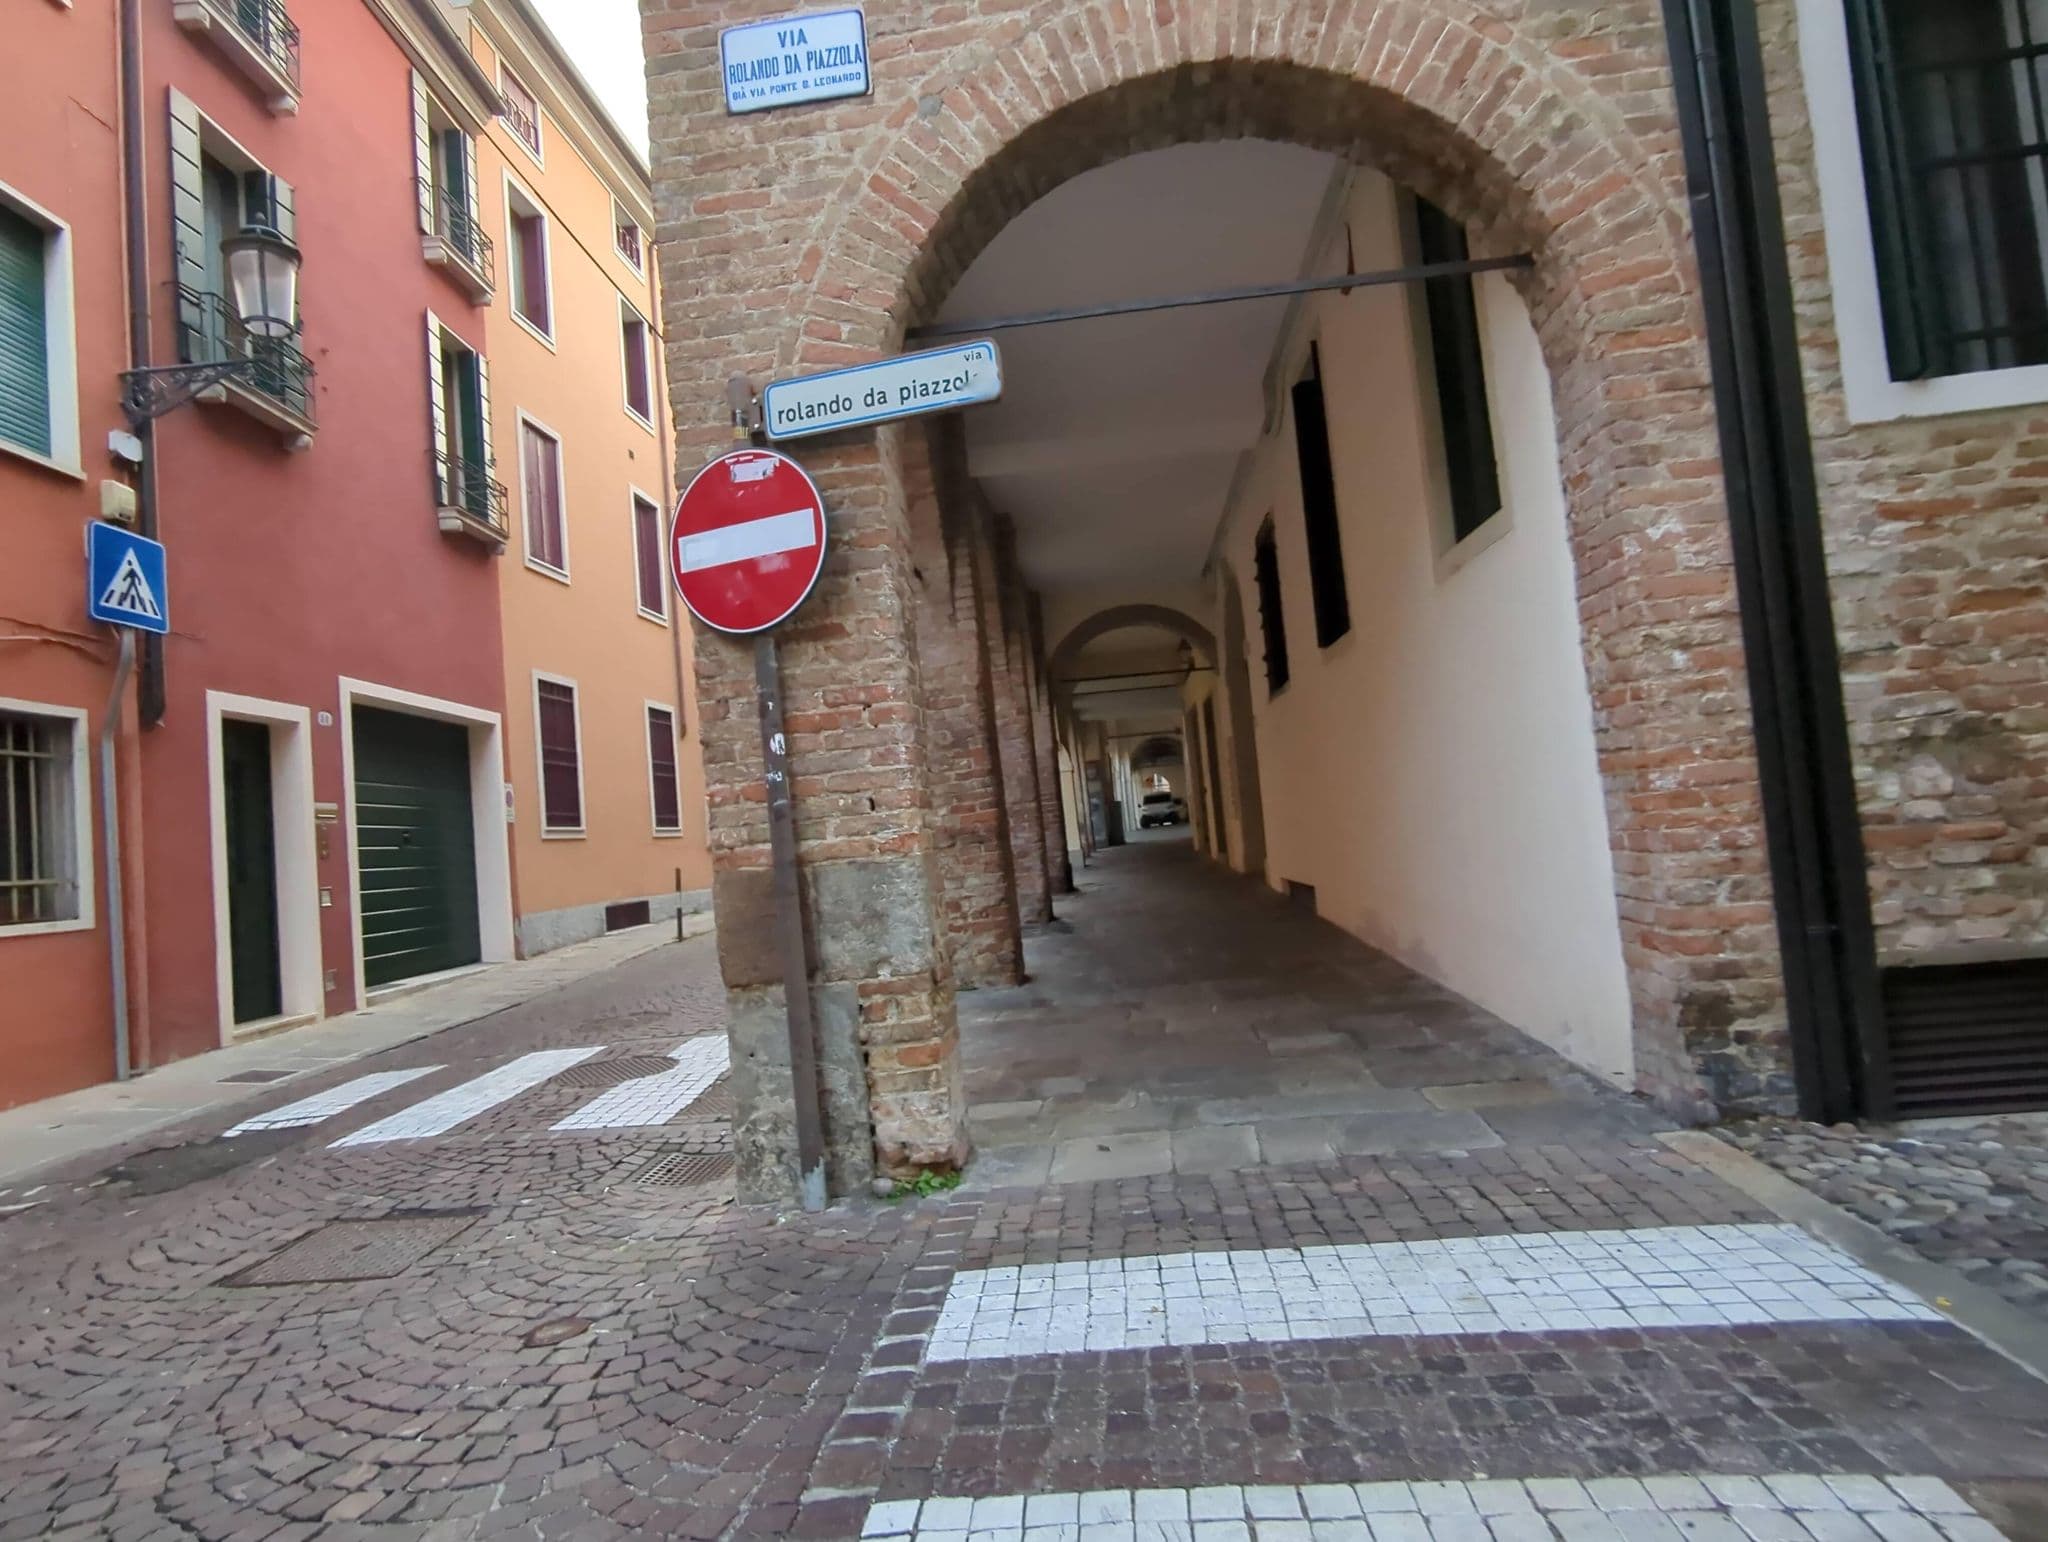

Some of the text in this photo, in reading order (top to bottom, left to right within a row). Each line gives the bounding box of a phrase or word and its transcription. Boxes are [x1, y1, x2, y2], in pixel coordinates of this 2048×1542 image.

[777, 28, 808, 48] VIA
[729, 43, 862, 85] ROLANDO DA PIAZZOLA
[750, 88, 766, 98] VIA
[770, 82, 798, 94] PONTE
[814, 72, 861, 87] LEONARDO
[964, 350, 982, 361] via
[778, 370, 978, 424] rolando da piazzol
